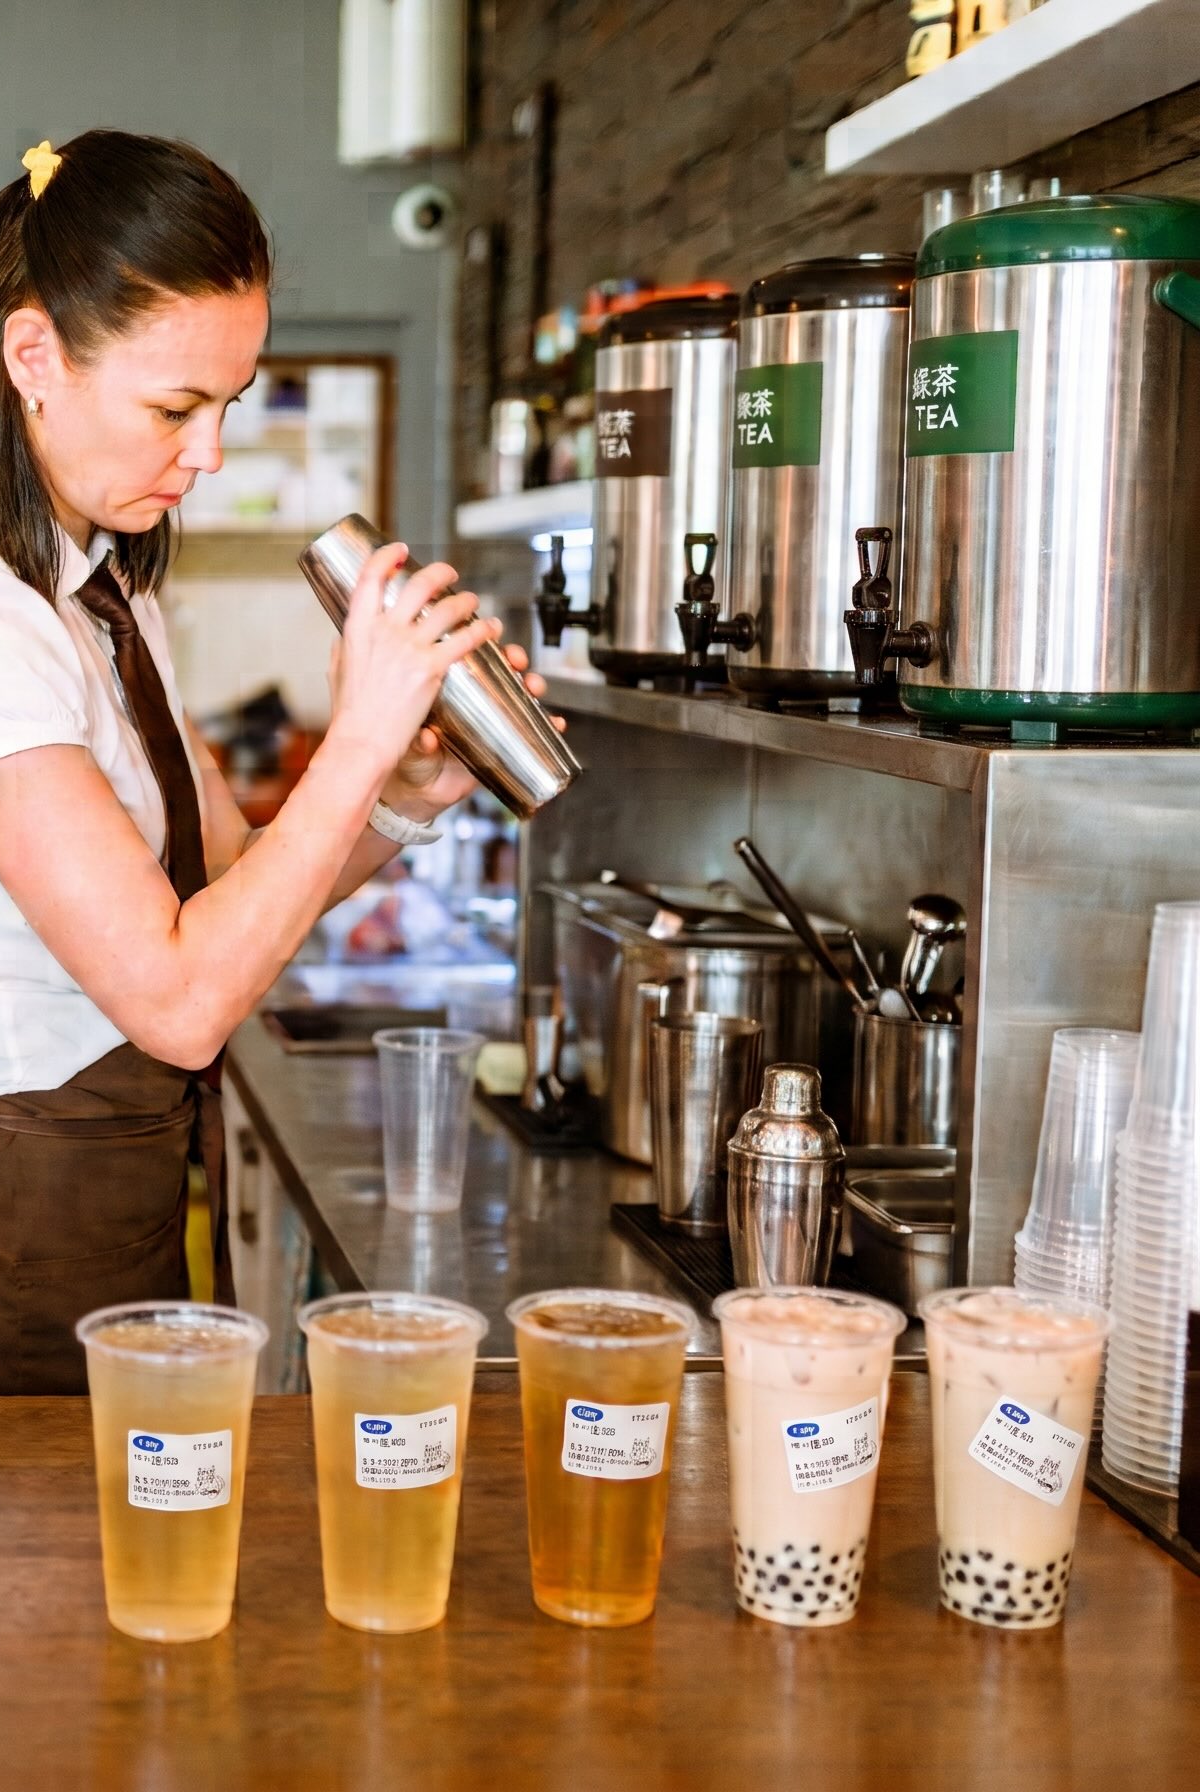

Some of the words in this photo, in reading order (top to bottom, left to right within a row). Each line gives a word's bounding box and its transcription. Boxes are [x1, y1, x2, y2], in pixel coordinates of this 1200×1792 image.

[914, 403, 959, 432] TEA
[738, 422, 774, 446] TEA
[599, 437, 632, 459] TEA
